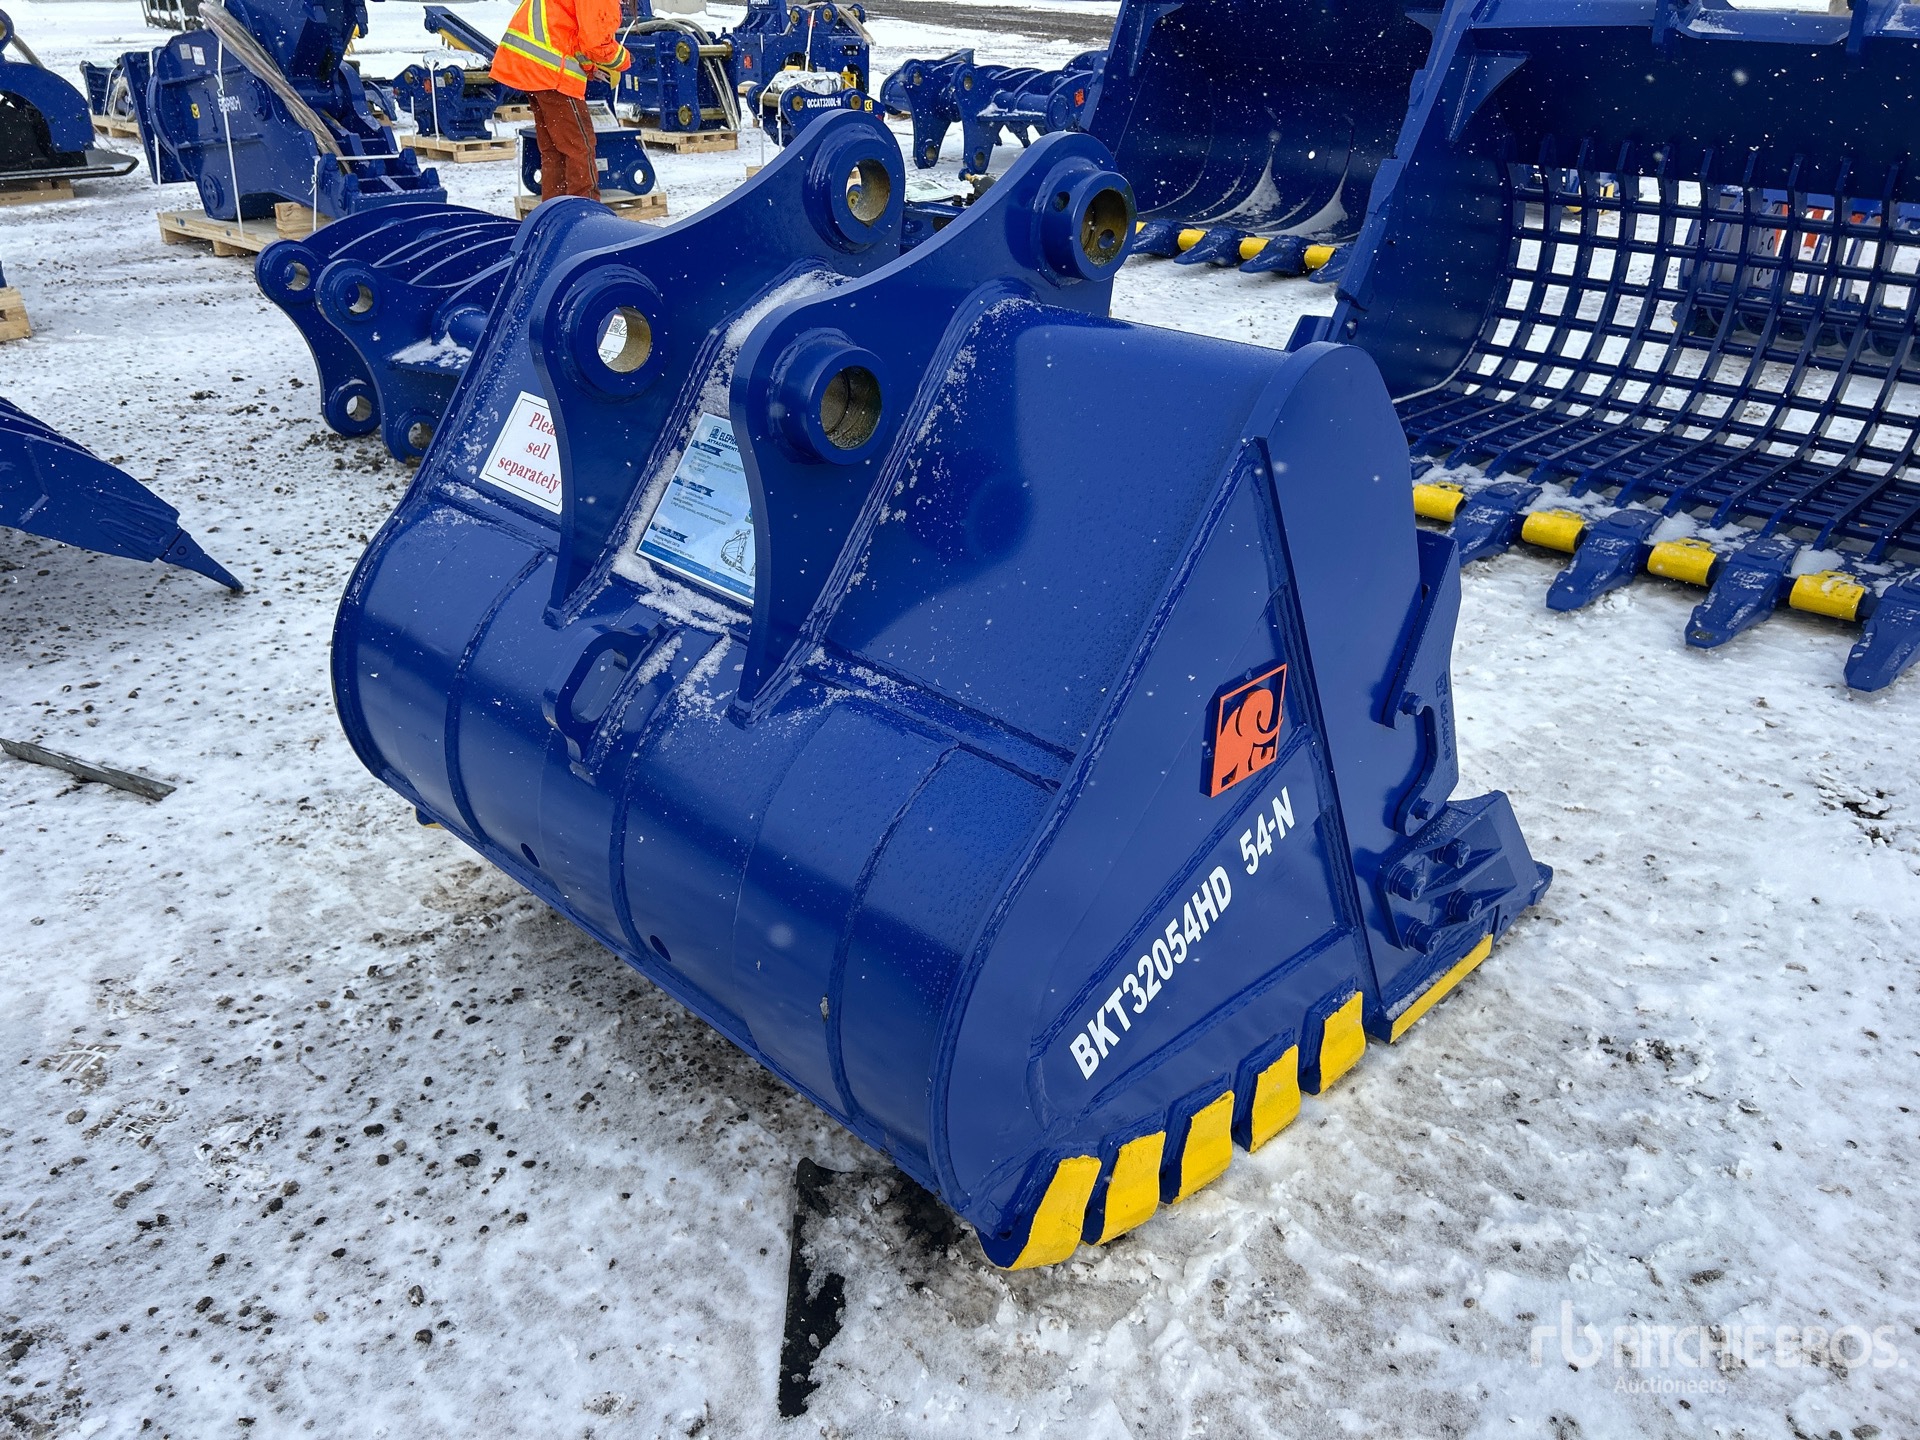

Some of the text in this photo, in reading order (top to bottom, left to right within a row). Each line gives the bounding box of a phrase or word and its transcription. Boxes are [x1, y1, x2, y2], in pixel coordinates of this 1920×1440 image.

[529, 411, 557, 438] Plea
[526, 441, 551, 460] sell
[497, 456, 561, 494] separately
[1069, 786, 1296, 1080] BKT32054HD 54-N
